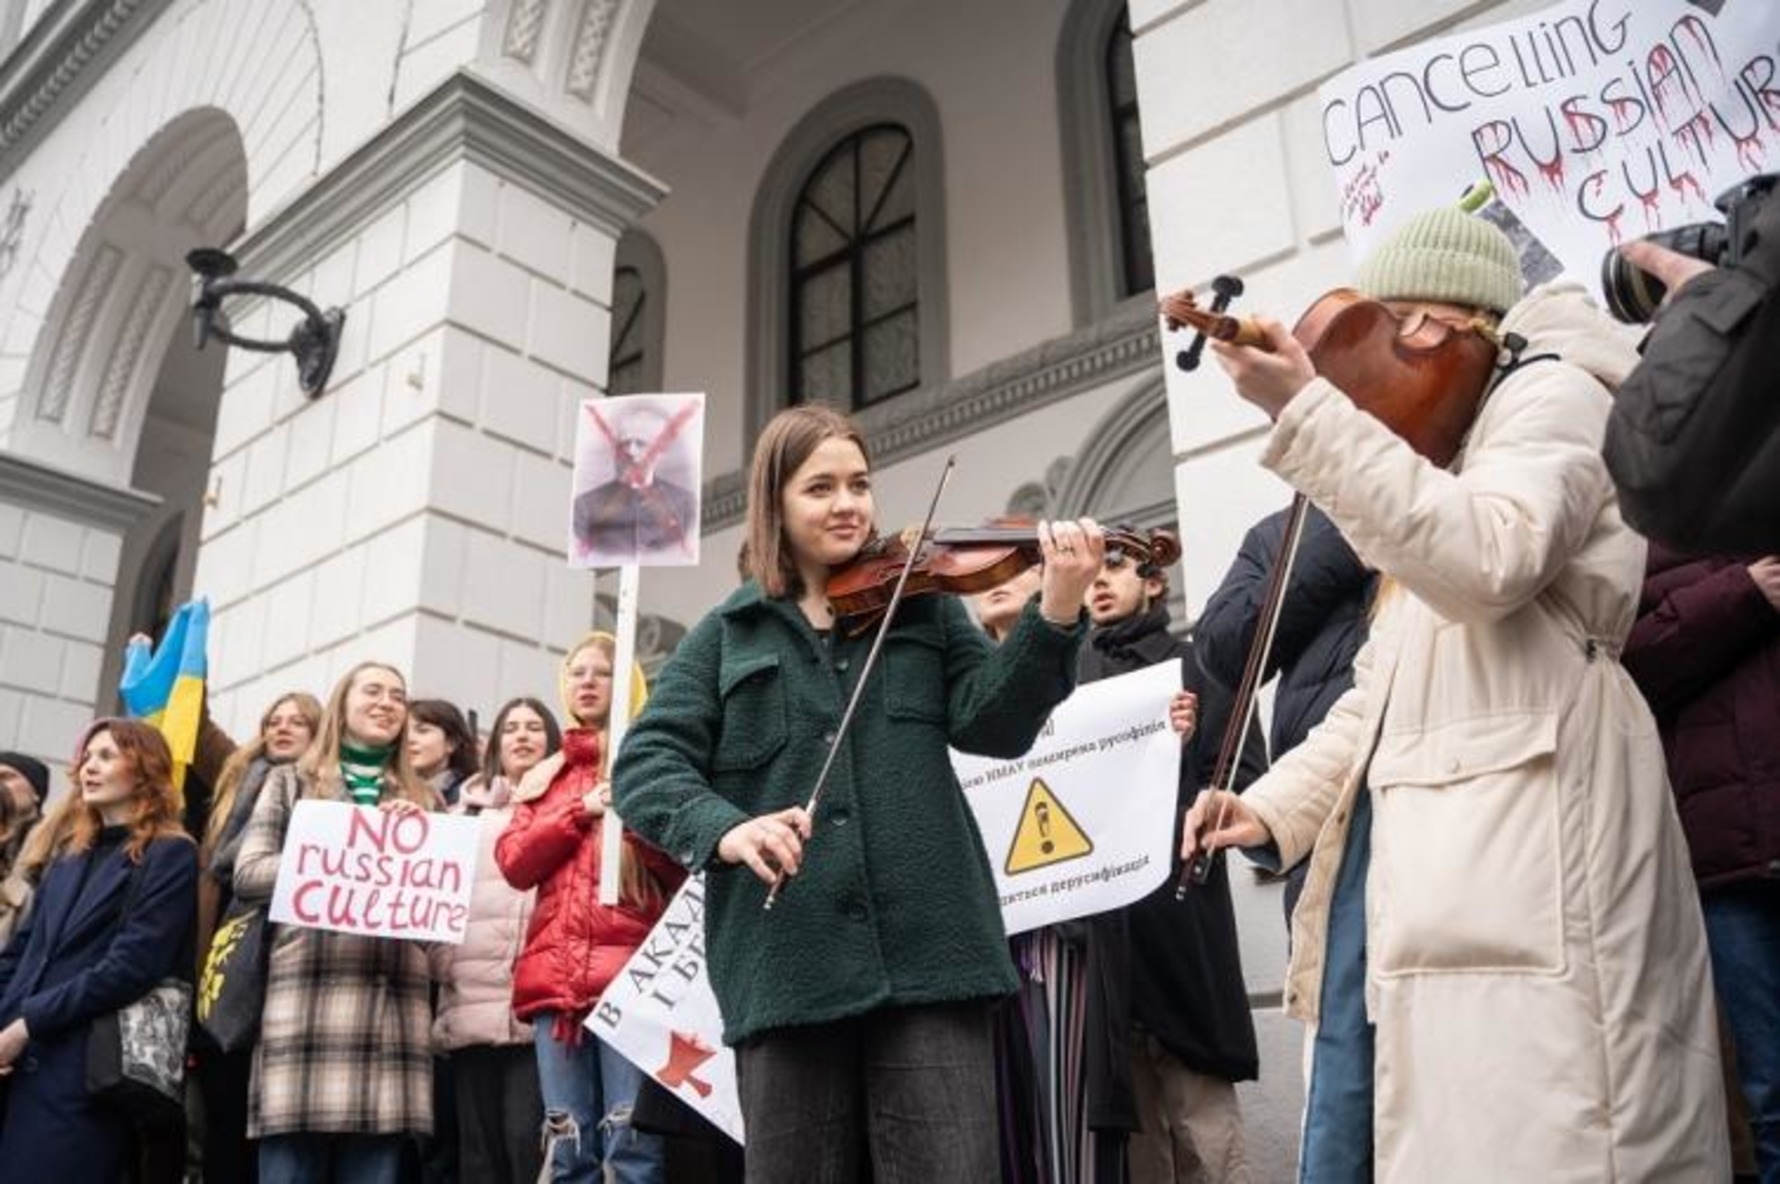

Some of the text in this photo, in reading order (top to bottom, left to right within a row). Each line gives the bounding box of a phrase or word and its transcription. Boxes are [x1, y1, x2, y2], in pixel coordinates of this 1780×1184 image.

[347, 806, 430, 855] NO
[296, 843, 462, 893] russian
[597, 874, 705, 1029] В АКАД
